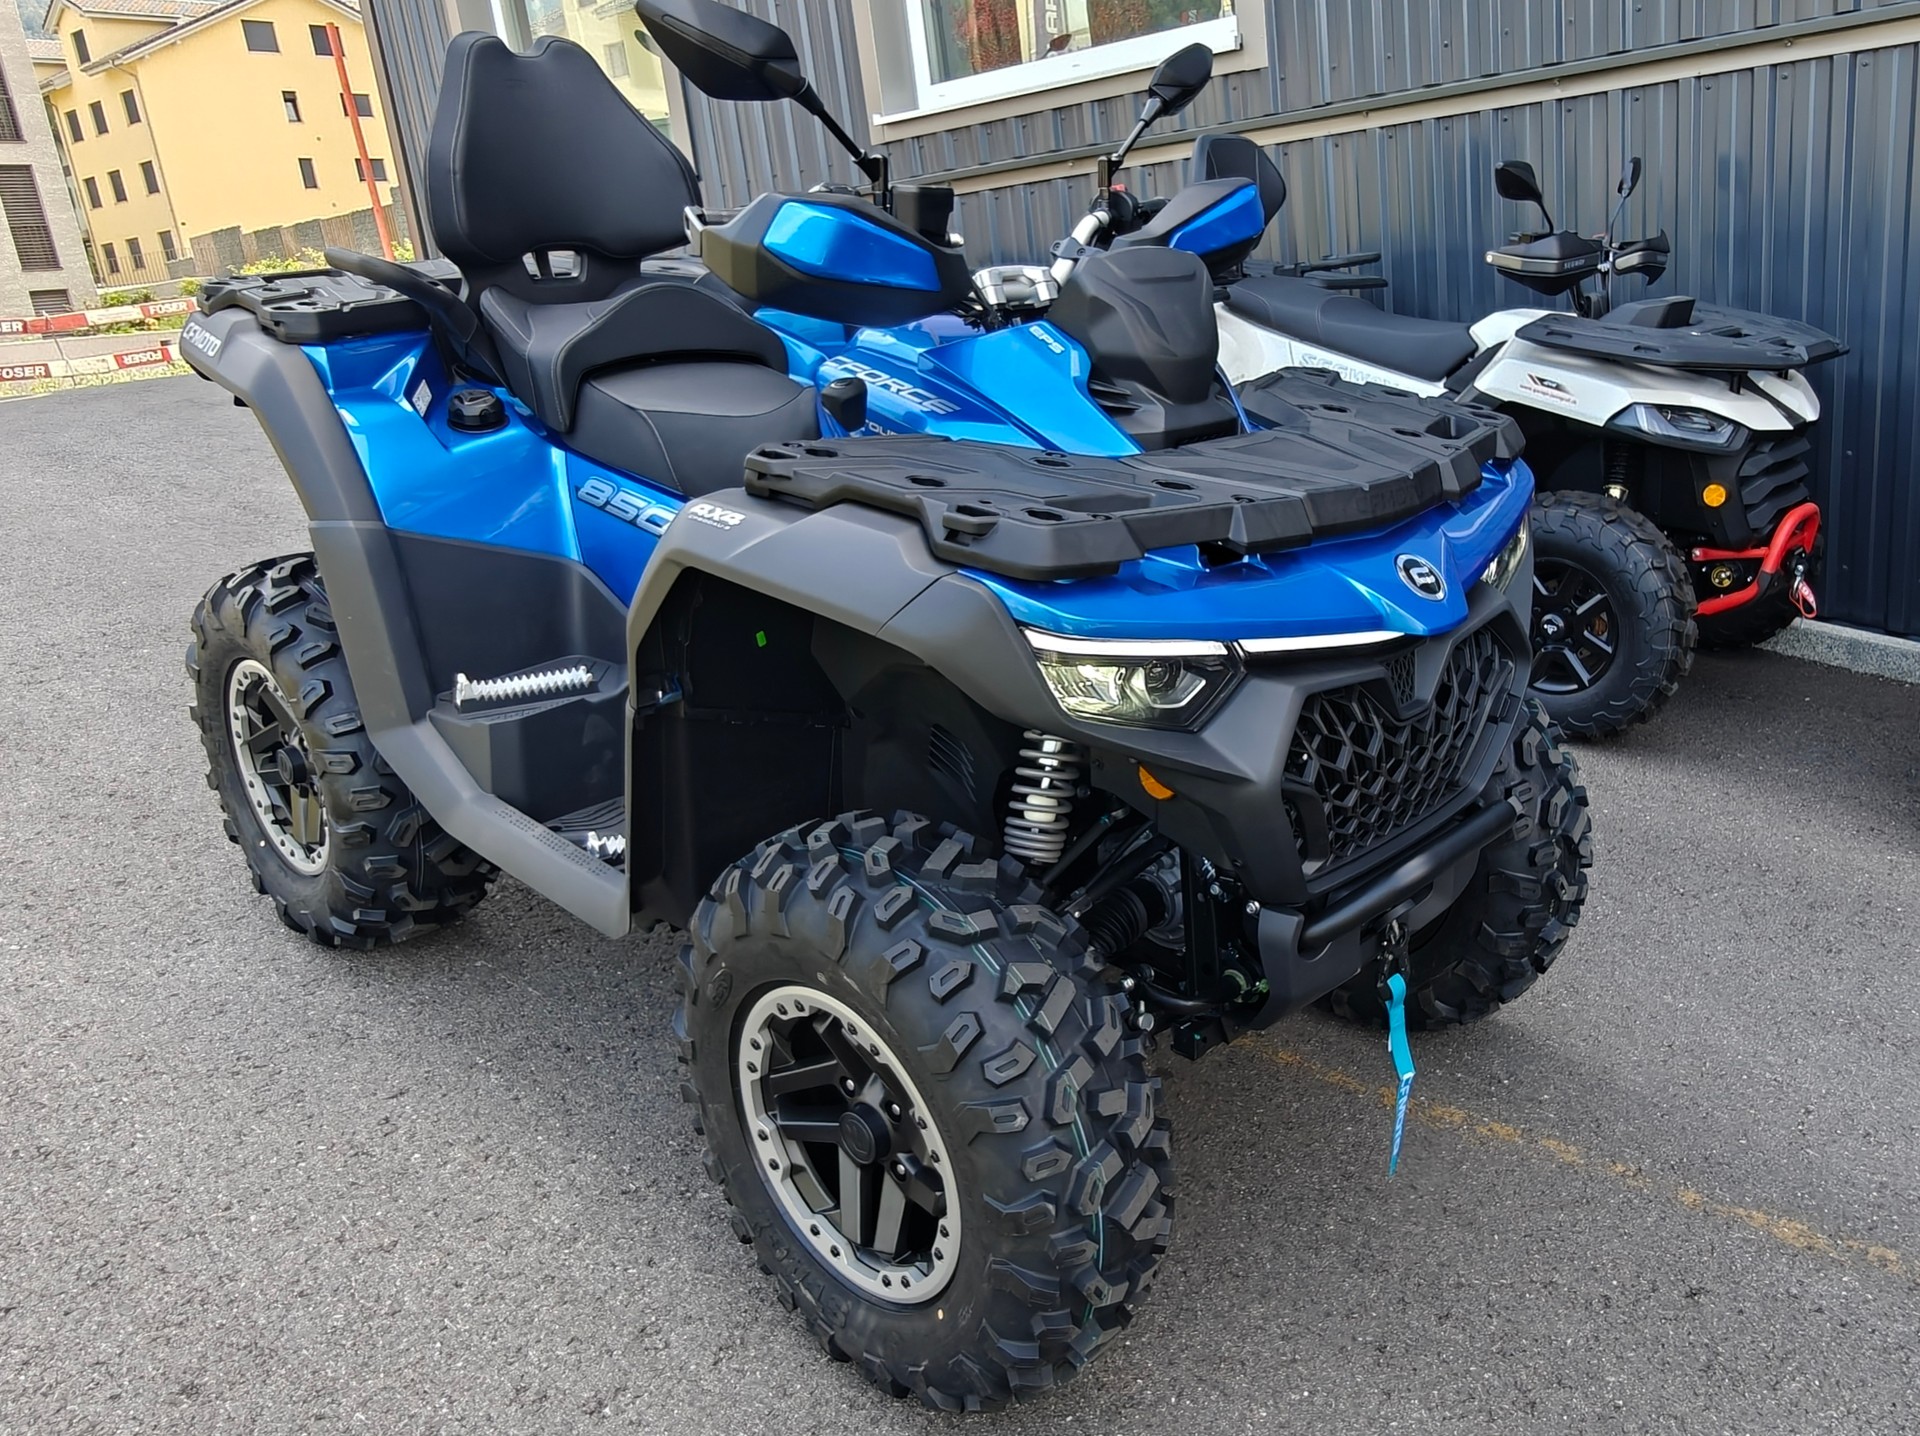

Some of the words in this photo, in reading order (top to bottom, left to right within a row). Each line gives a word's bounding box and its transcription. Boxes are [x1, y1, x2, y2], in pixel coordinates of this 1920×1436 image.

[149, 301, 188, 315] FOSER
[0, 320, 24, 333] ER
[183, 321, 222, 357] CFMOTO
[1029, 325, 1065, 353] EPS
[122, 349, 163, 365] FOSER
[0, 364, 46, 379] OSER
[822, 356, 962, 415] CFORCE
[578, 476, 680, 536] 850
